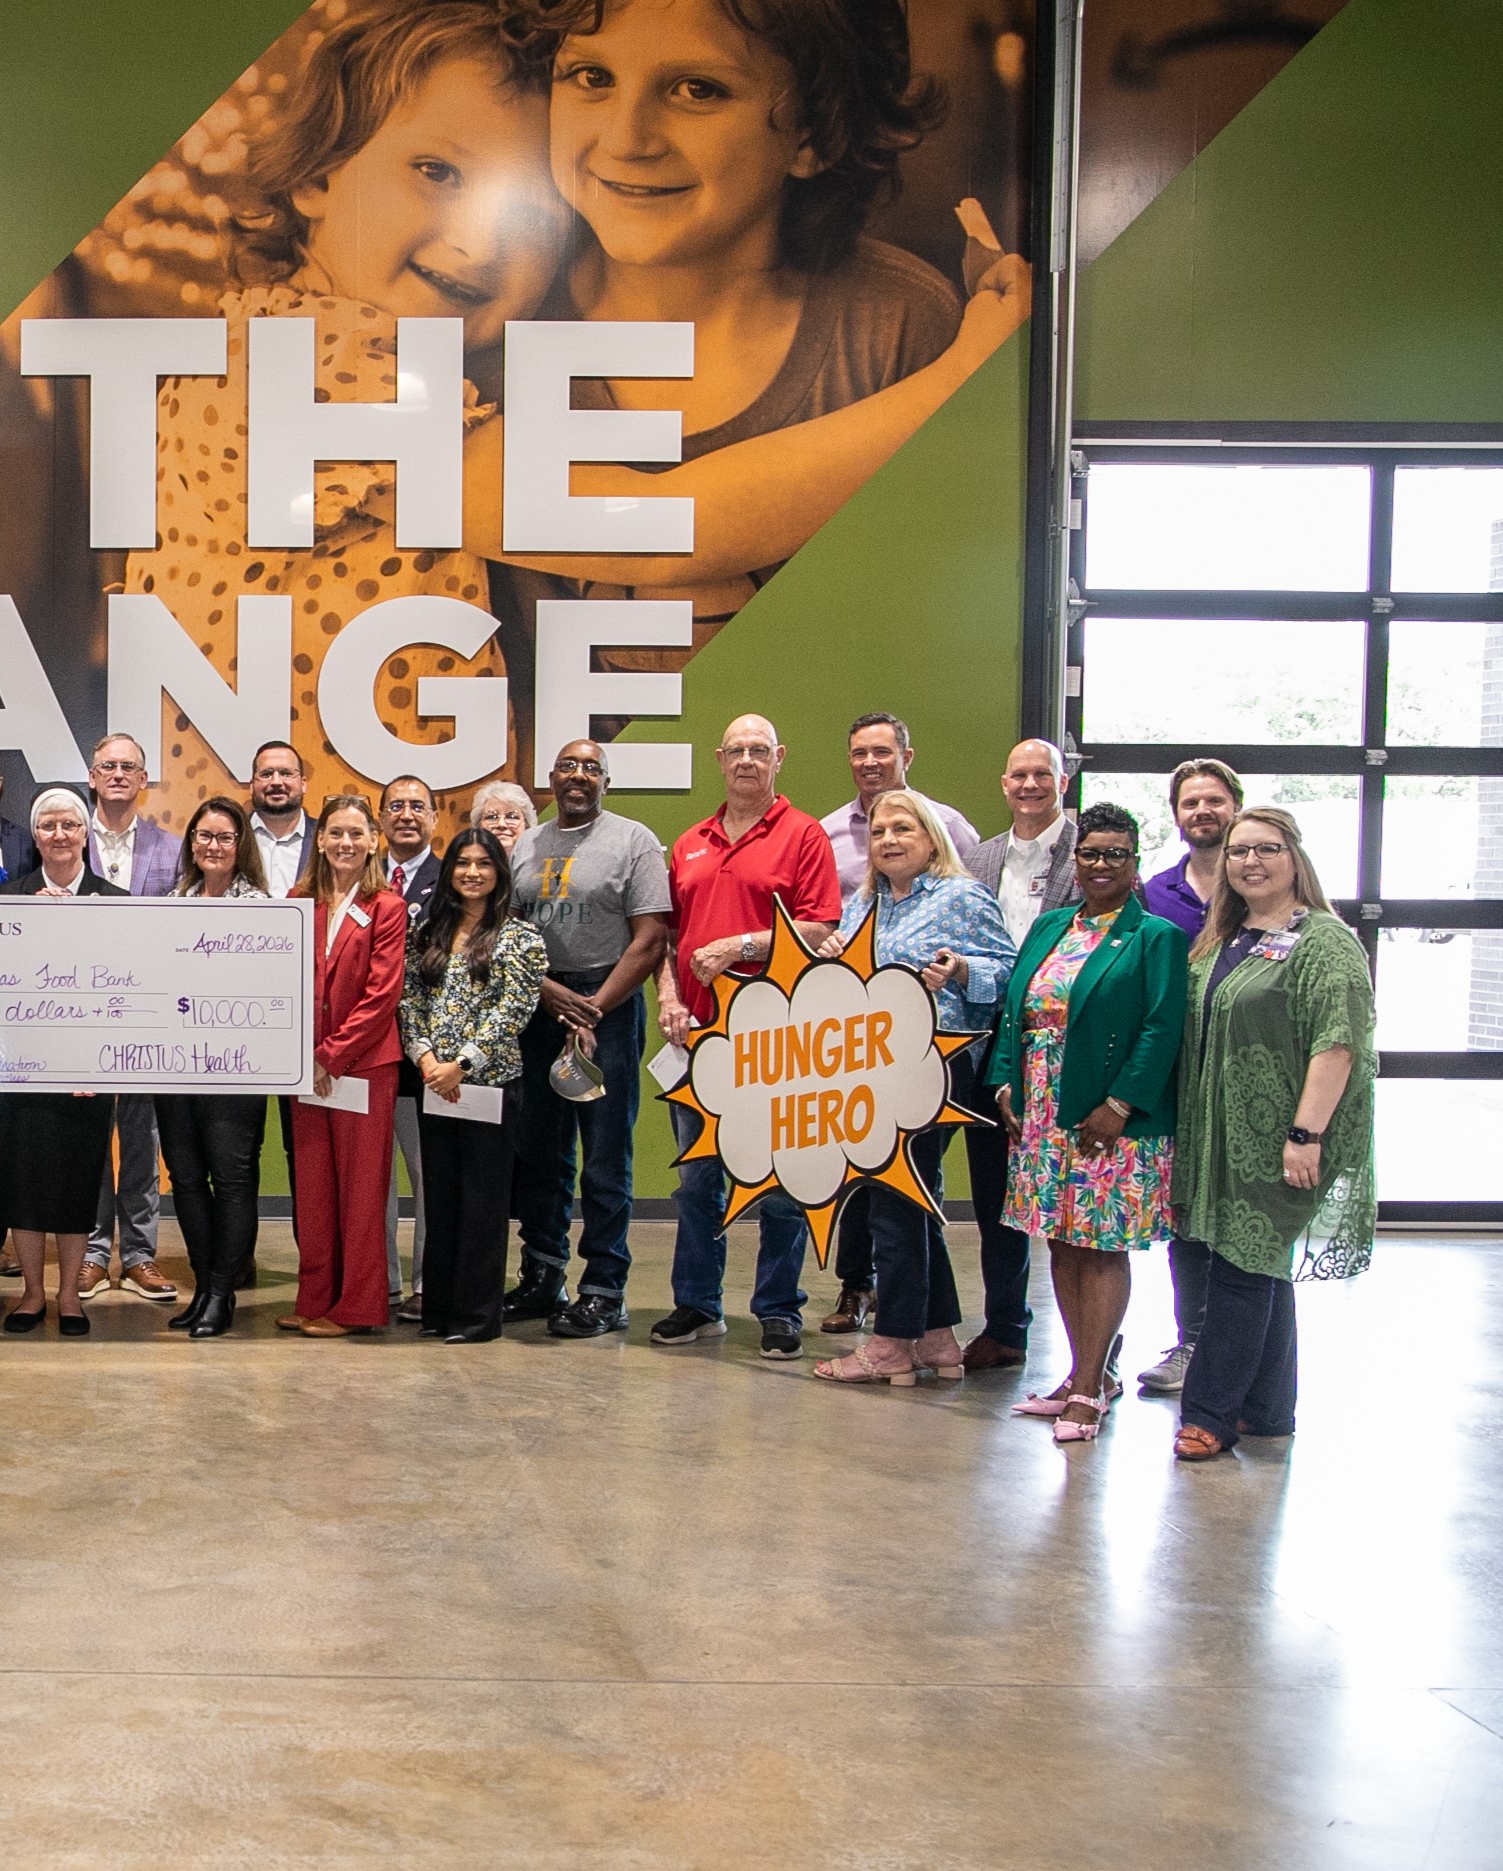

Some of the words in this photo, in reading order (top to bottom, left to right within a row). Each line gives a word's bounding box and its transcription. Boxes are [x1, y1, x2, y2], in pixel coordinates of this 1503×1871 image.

[21, 318, 695, 553] THE
[522, 901, 593, 925] HOPE
[193, 932, 234, 958] April
[35, 963, 81, 989] Food
[90, 965, 142, 989] Bank
[5, 1000, 89, 1022] dollars
[99, 1044, 186, 1073] CHRISTUS
[190, 1042, 261, 1074] Health
[734, 1010, 895, 1089] HUNGER
[770, 1084, 875, 1152] HERO
